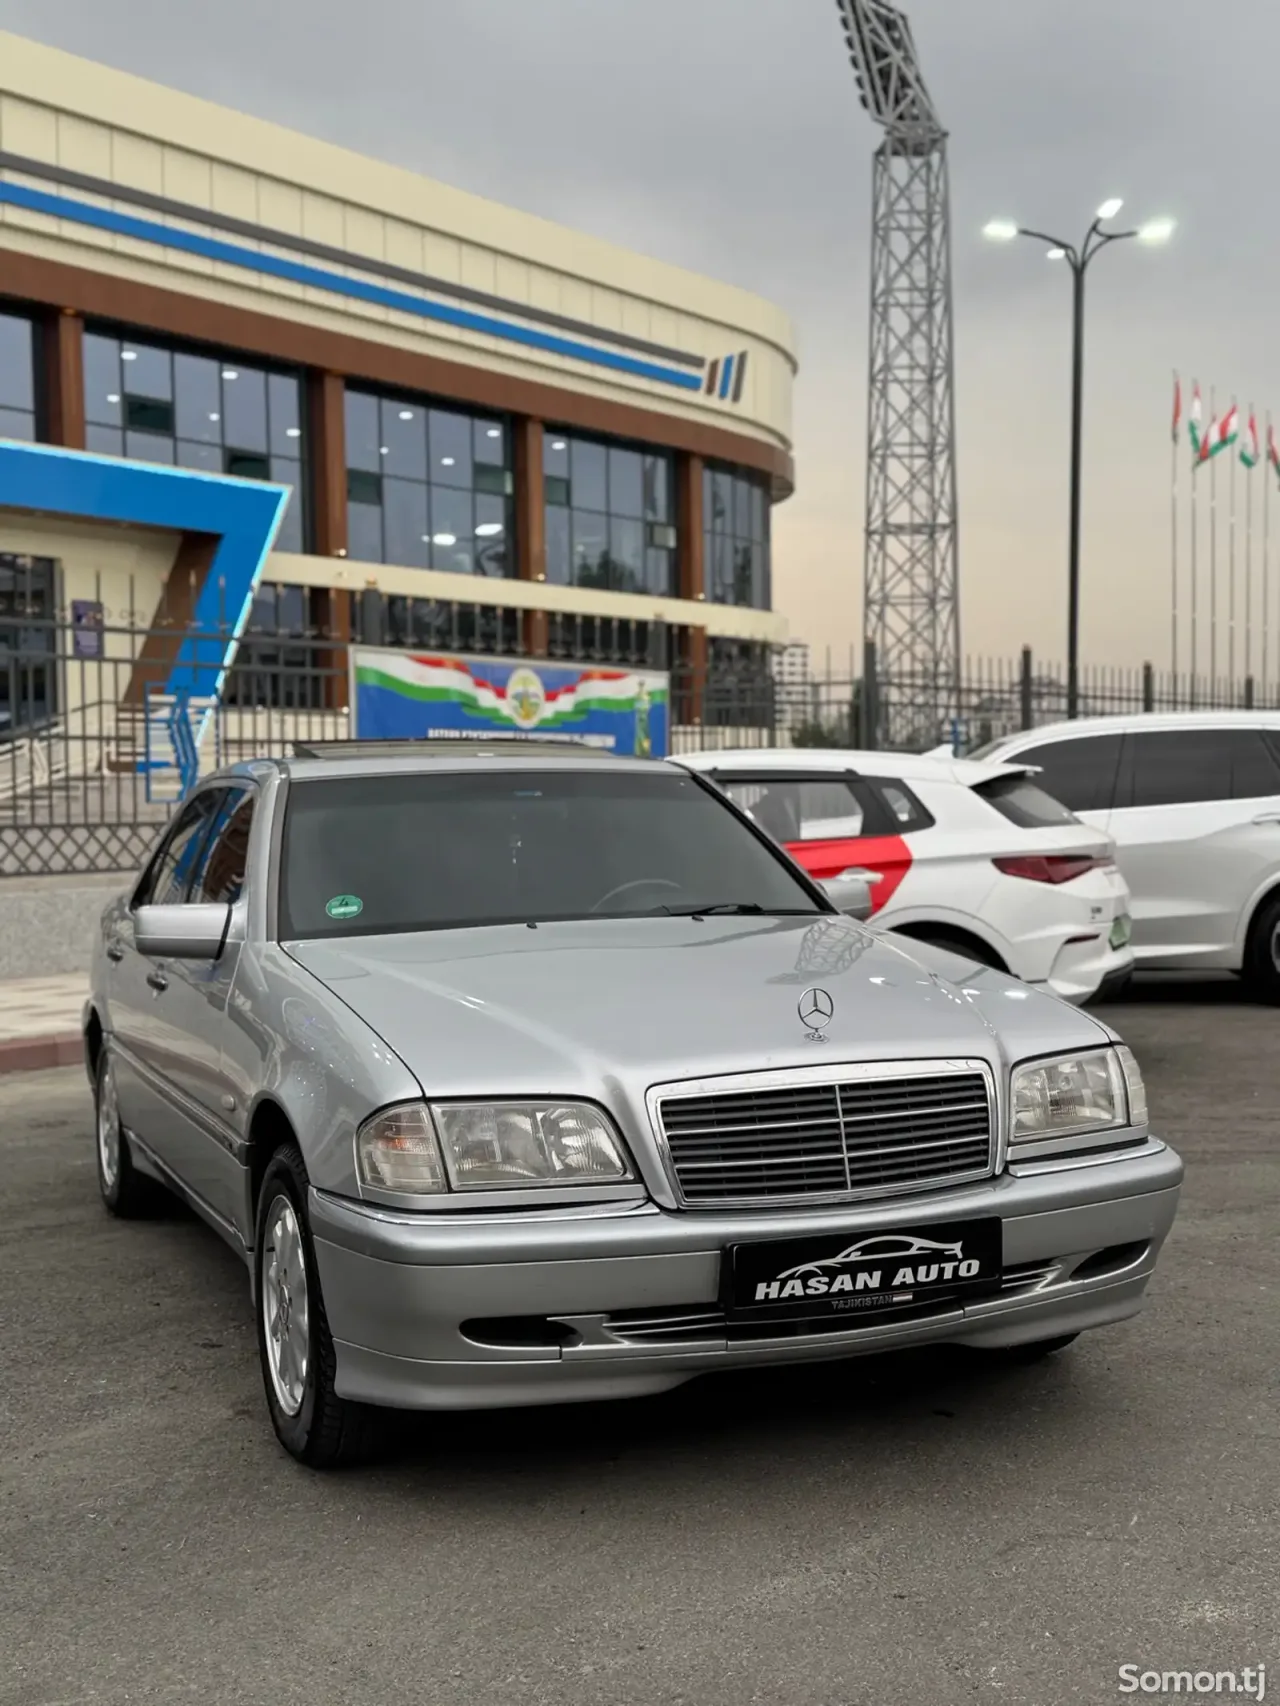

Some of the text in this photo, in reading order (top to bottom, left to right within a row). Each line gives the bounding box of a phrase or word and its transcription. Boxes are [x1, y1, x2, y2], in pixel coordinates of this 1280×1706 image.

[755, 1259, 980, 1301] HASAN AUTO
[831, 1295, 893, 1310] TAJIKISTAN
